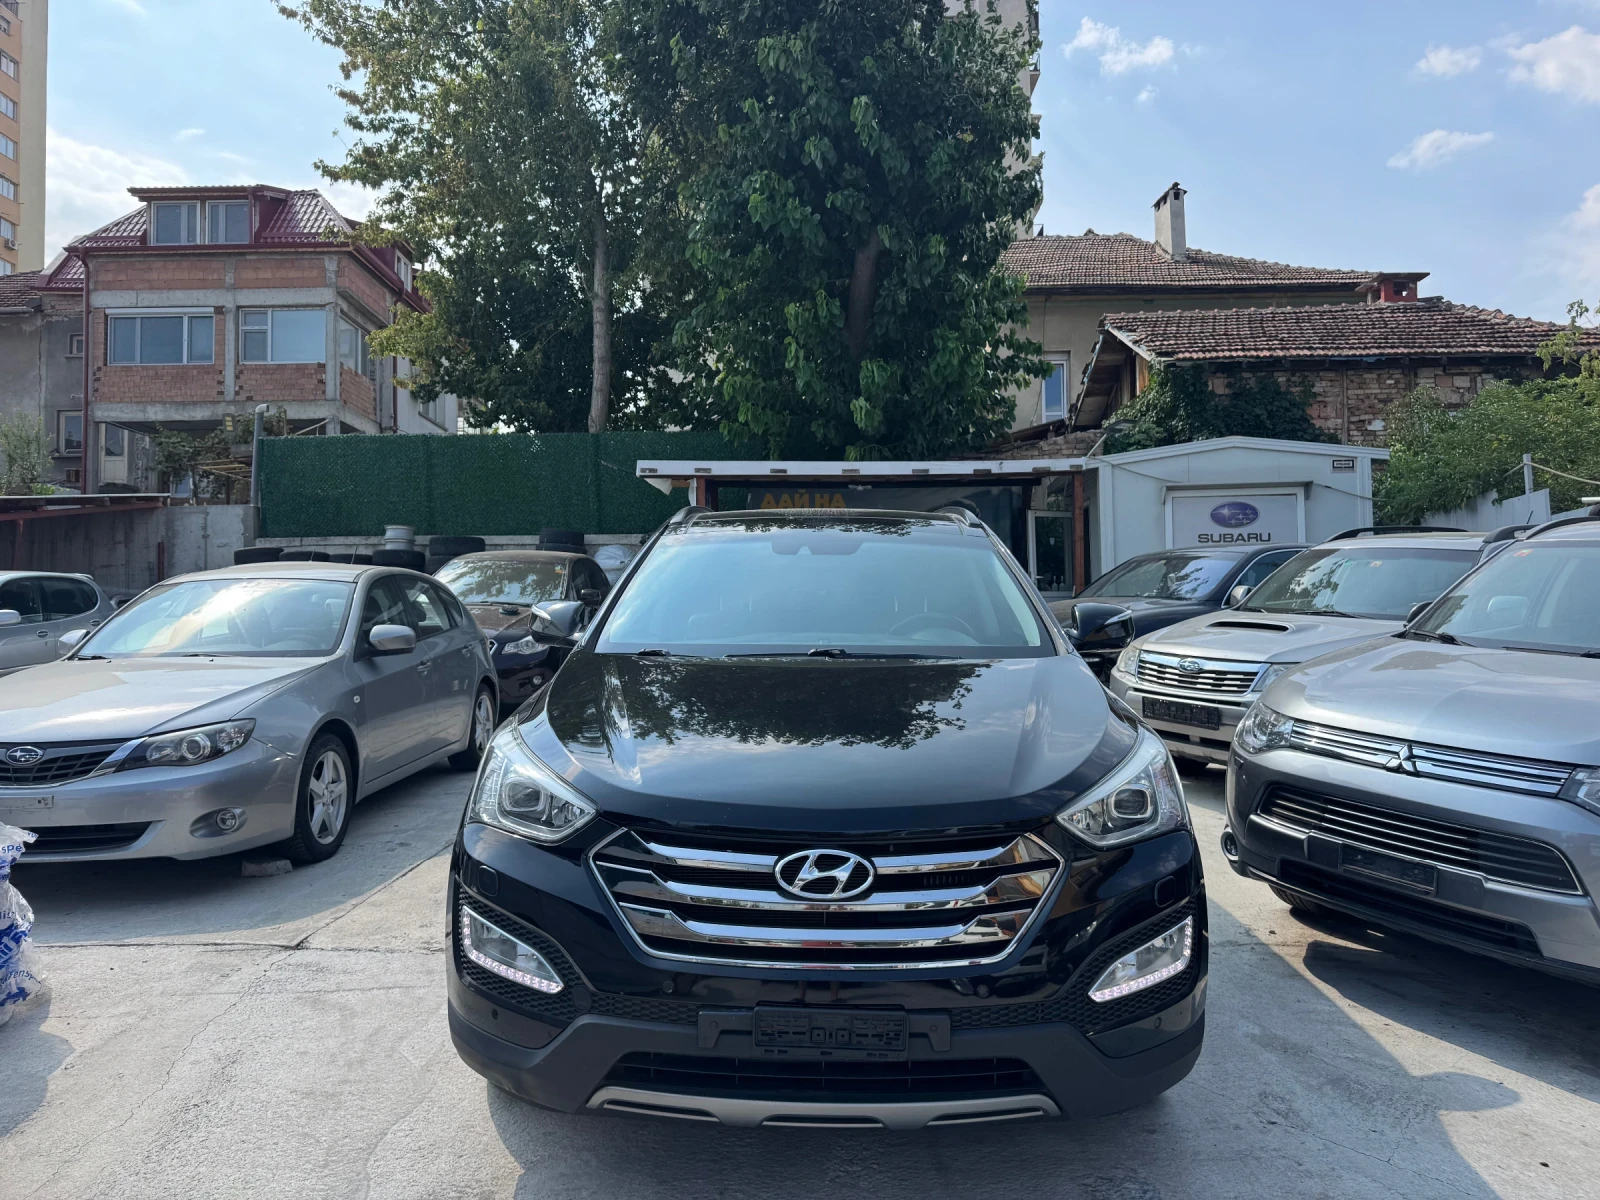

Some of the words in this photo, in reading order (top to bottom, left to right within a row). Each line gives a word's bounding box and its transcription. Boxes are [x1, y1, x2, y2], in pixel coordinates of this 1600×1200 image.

[760, 489, 810, 508] ДАЙ
[815, 493, 847, 508] НА
[1197, 532, 1272, 544] SUBARU
